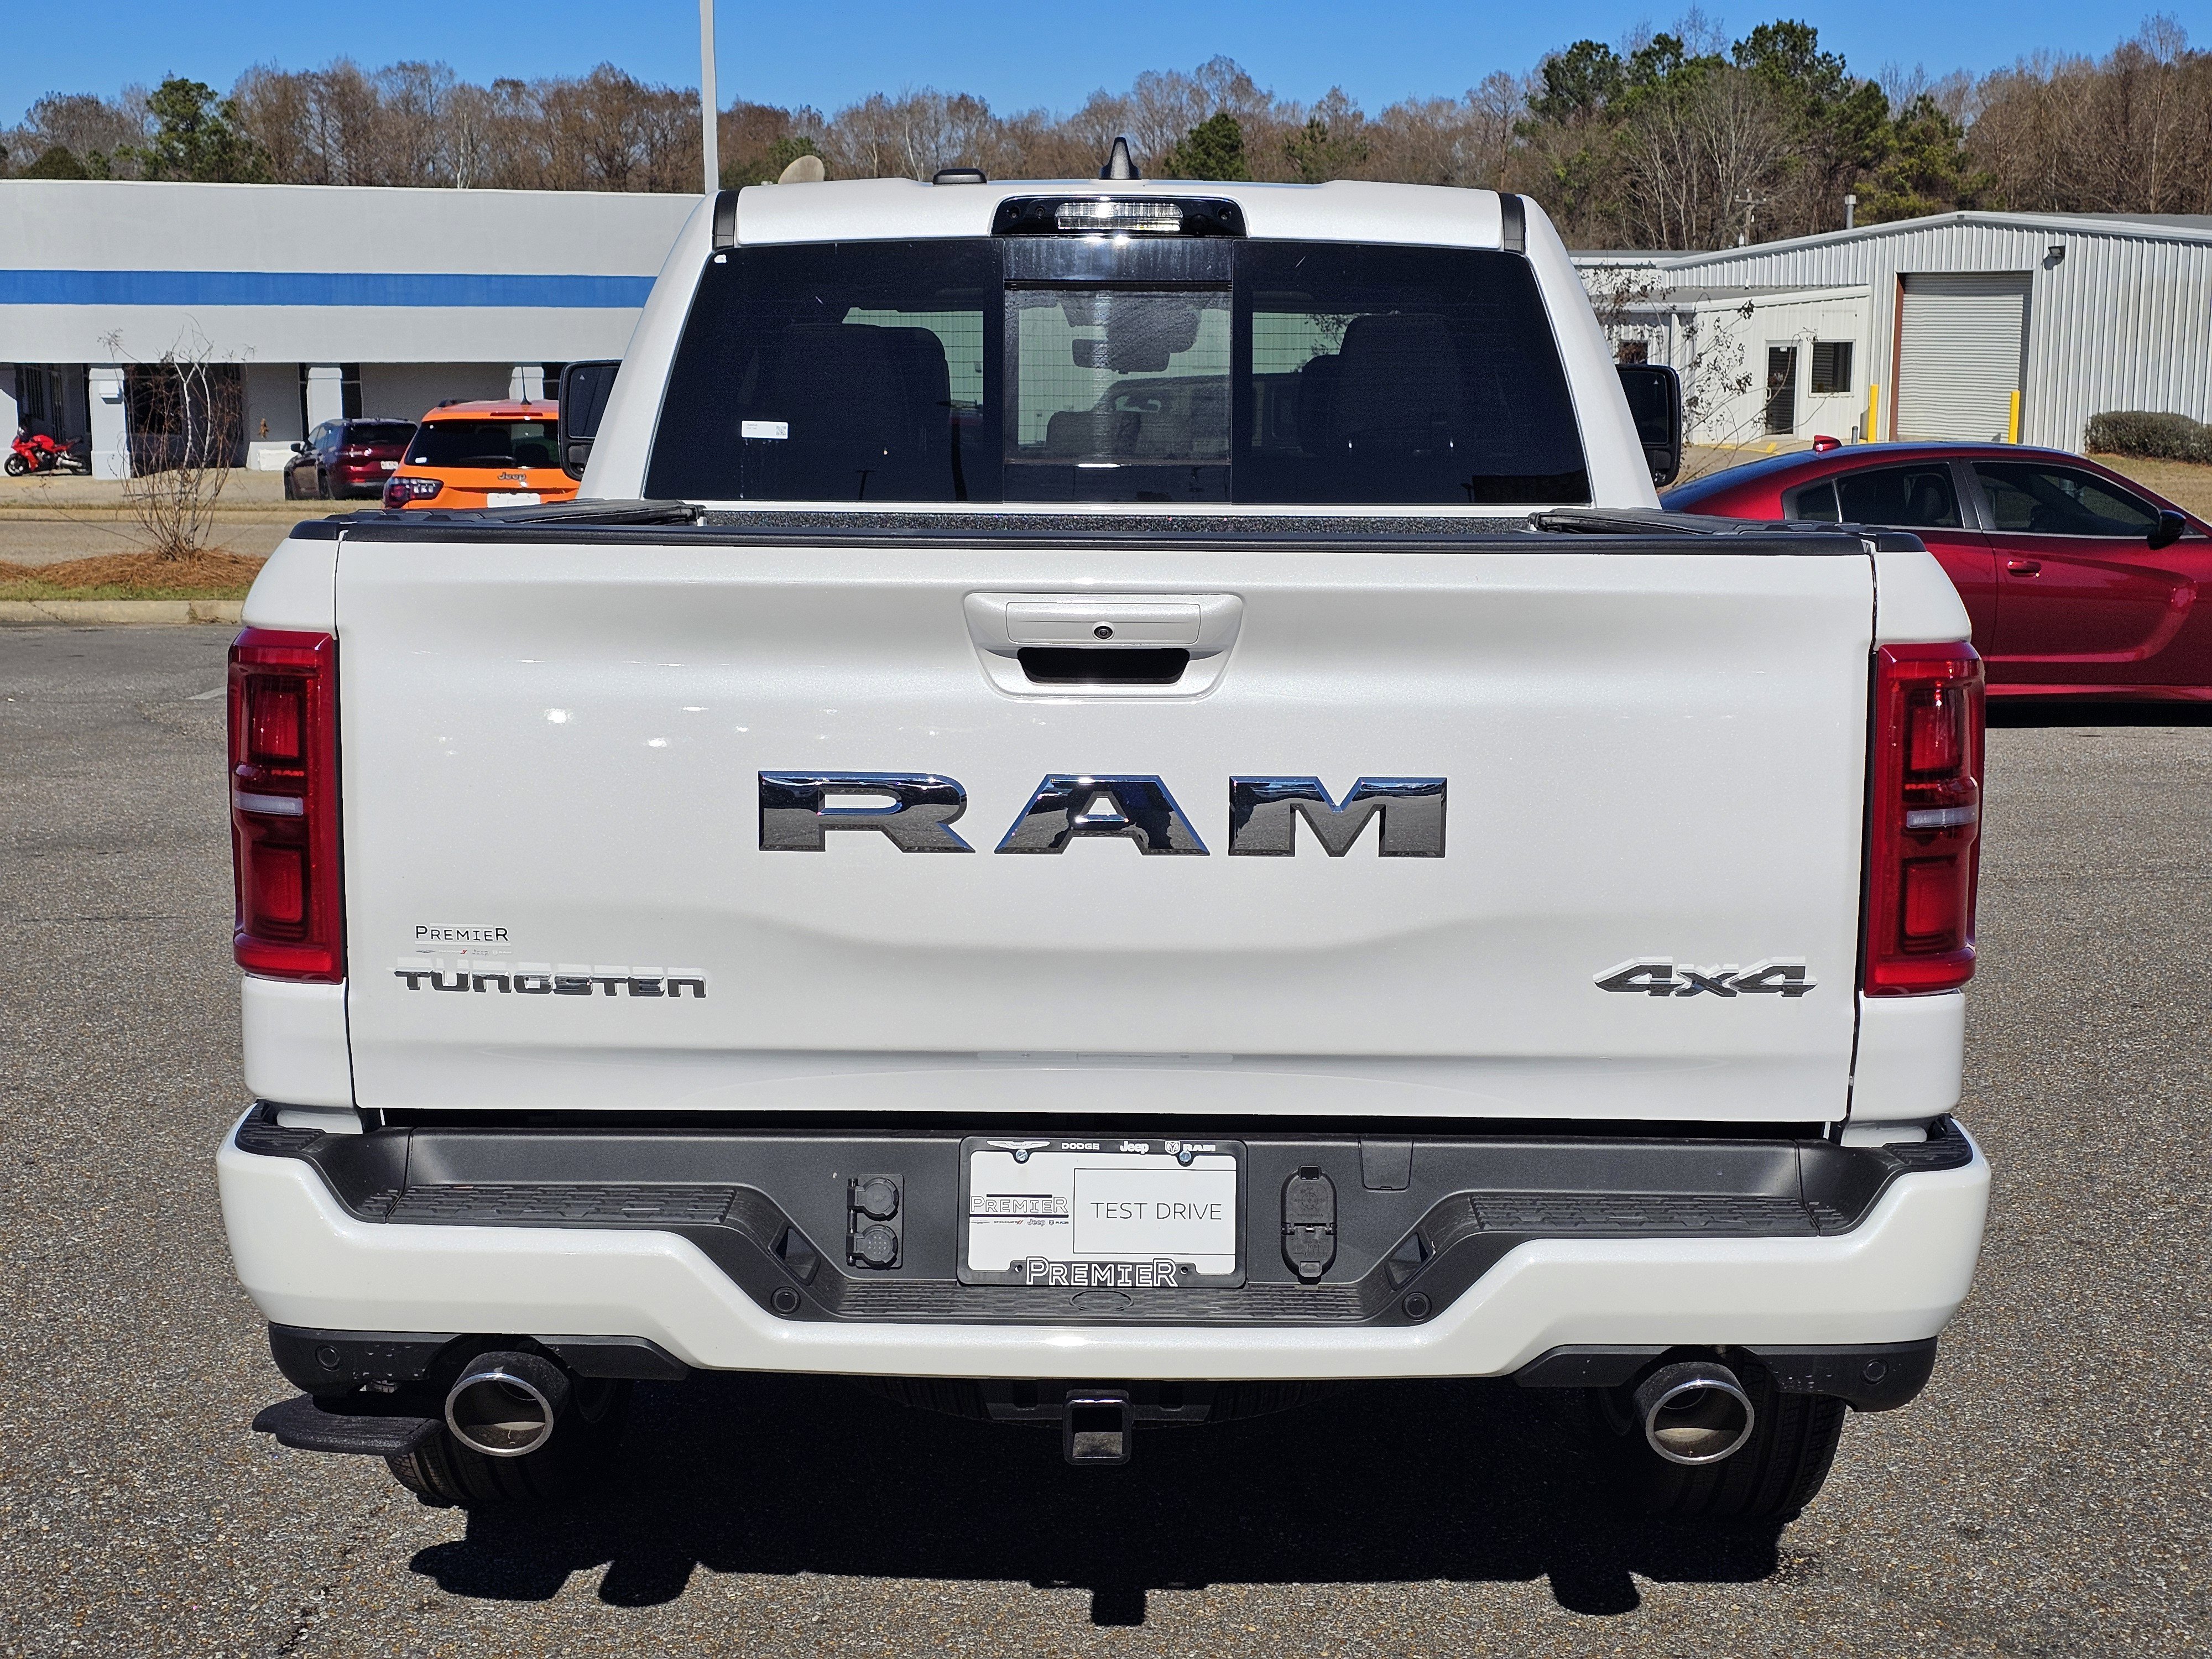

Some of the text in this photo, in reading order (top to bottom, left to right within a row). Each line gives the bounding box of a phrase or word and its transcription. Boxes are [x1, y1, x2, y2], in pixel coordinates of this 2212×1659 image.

[498, 472, 526, 481] Jeep
[758, 770, 1447, 857] RAM
[416, 926, 509, 941] PREMIER
[1119, 1140, 1149, 1154] Jeep
[1183, 1144, 1216, 1152] RAM
[971, 1196, 1068, 1213] PREMIER
[1091, 1202, 1222, 1220] TEST DRIVE
[1025, 1257, 1178, 1287] PREMIER
